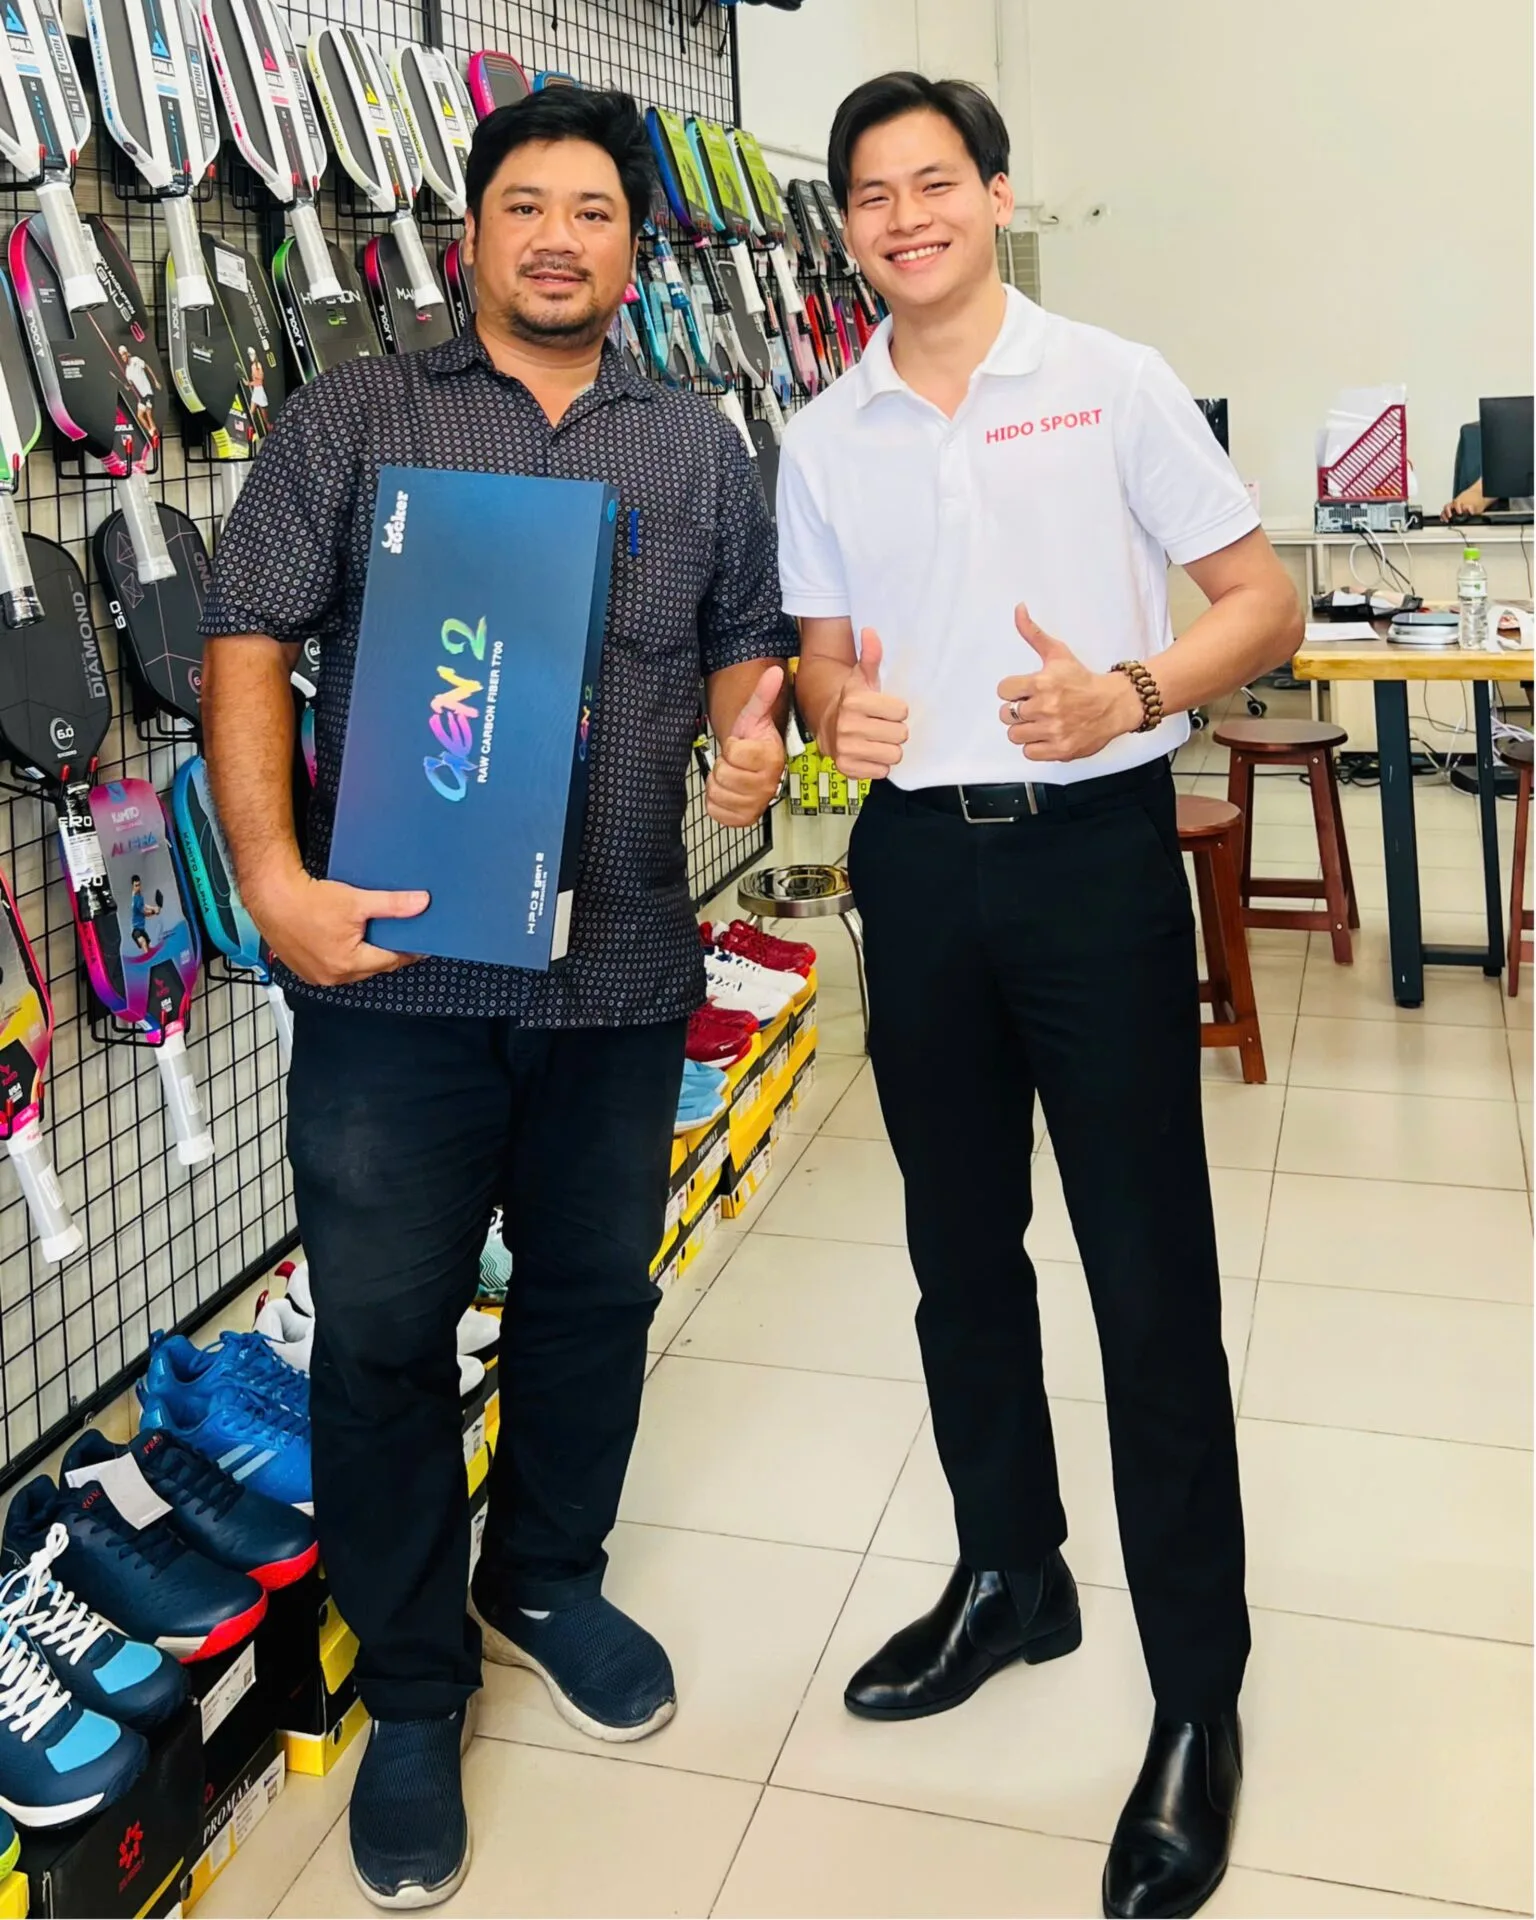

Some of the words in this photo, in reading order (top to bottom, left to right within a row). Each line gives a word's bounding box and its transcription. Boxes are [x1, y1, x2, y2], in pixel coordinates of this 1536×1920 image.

[322, 95, 344, 151] SCORPEUS
[96, 266, 132, 322] GNUS
[26, 309, 41, 350] JOOLA
[286, 307, 301, 340] JOOLA
[379, 304, 391, 336] JOOLA
[986, 421, 1034, 444] HIDO
[1040, 408, 1102, 432] SPORT
[389, 490, 409, 554] zocker
[109, 600, 126, 629] 6.0
[72, 591, 106, 698] DIAMOND
[441, 616, 487, 661] 2
[492, 641, 504, 668] T700
[487, 669, 501, 703] FIBER
[56, 726, 75, 740] 6.0
[480, 705, 496, 754] CARBON
[477, 756, 490, 783] RAW
[183, 831, 198, 871] KAMITO
[195, 877, 210, 914] ALPHA
[534, 864, 544, 888] gen
[203, 1775, 253, 1846] PROMAX
